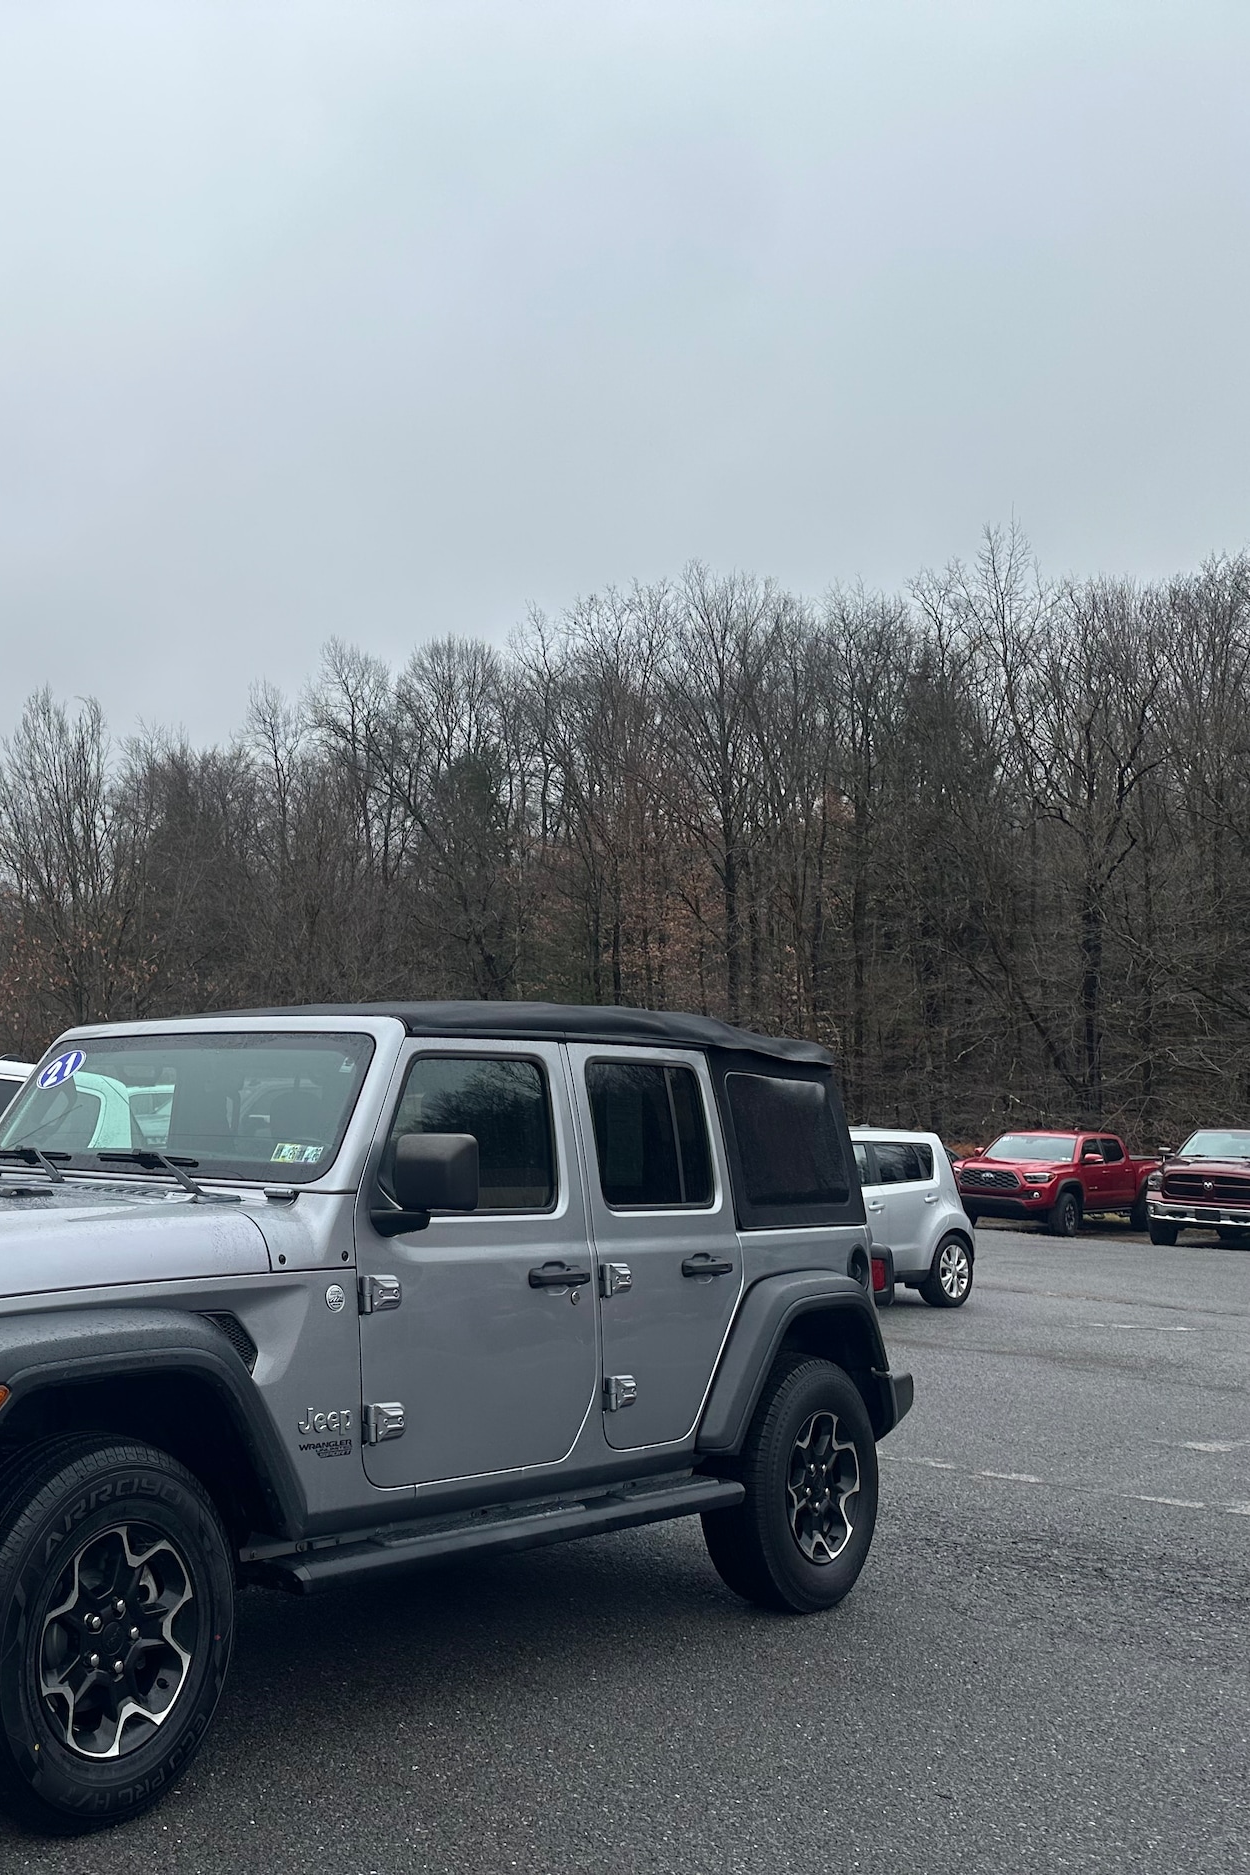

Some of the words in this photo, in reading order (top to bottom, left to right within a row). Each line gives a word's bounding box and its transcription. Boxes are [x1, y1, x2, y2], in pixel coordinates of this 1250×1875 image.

[43, 1052, 78, 1087] 21
[298, 1407, 352, 1435] Jeep
[298, 1439, 353, 1451] WRANGLER
[44, 1478, 184, 1566] ARROYO
